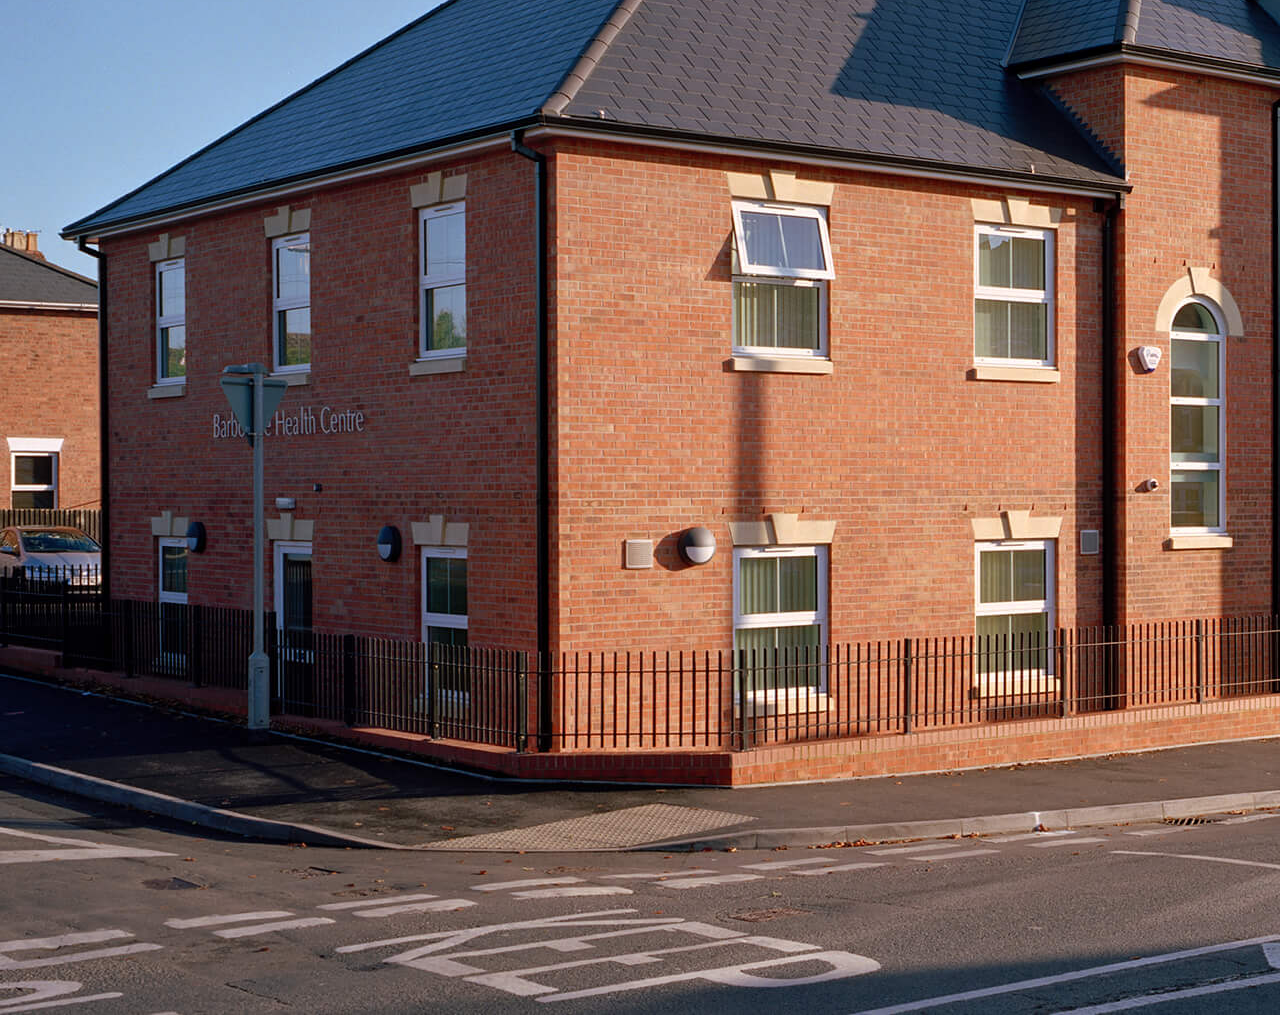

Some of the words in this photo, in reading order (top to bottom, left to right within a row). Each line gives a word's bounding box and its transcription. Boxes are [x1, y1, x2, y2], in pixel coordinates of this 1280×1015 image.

[212, 412, 272, 438] Barboe
[275, 406, 317, 436] Health
[320, 406, 365, 434] Centre
[335, 908, 882, 1003] KEEP
